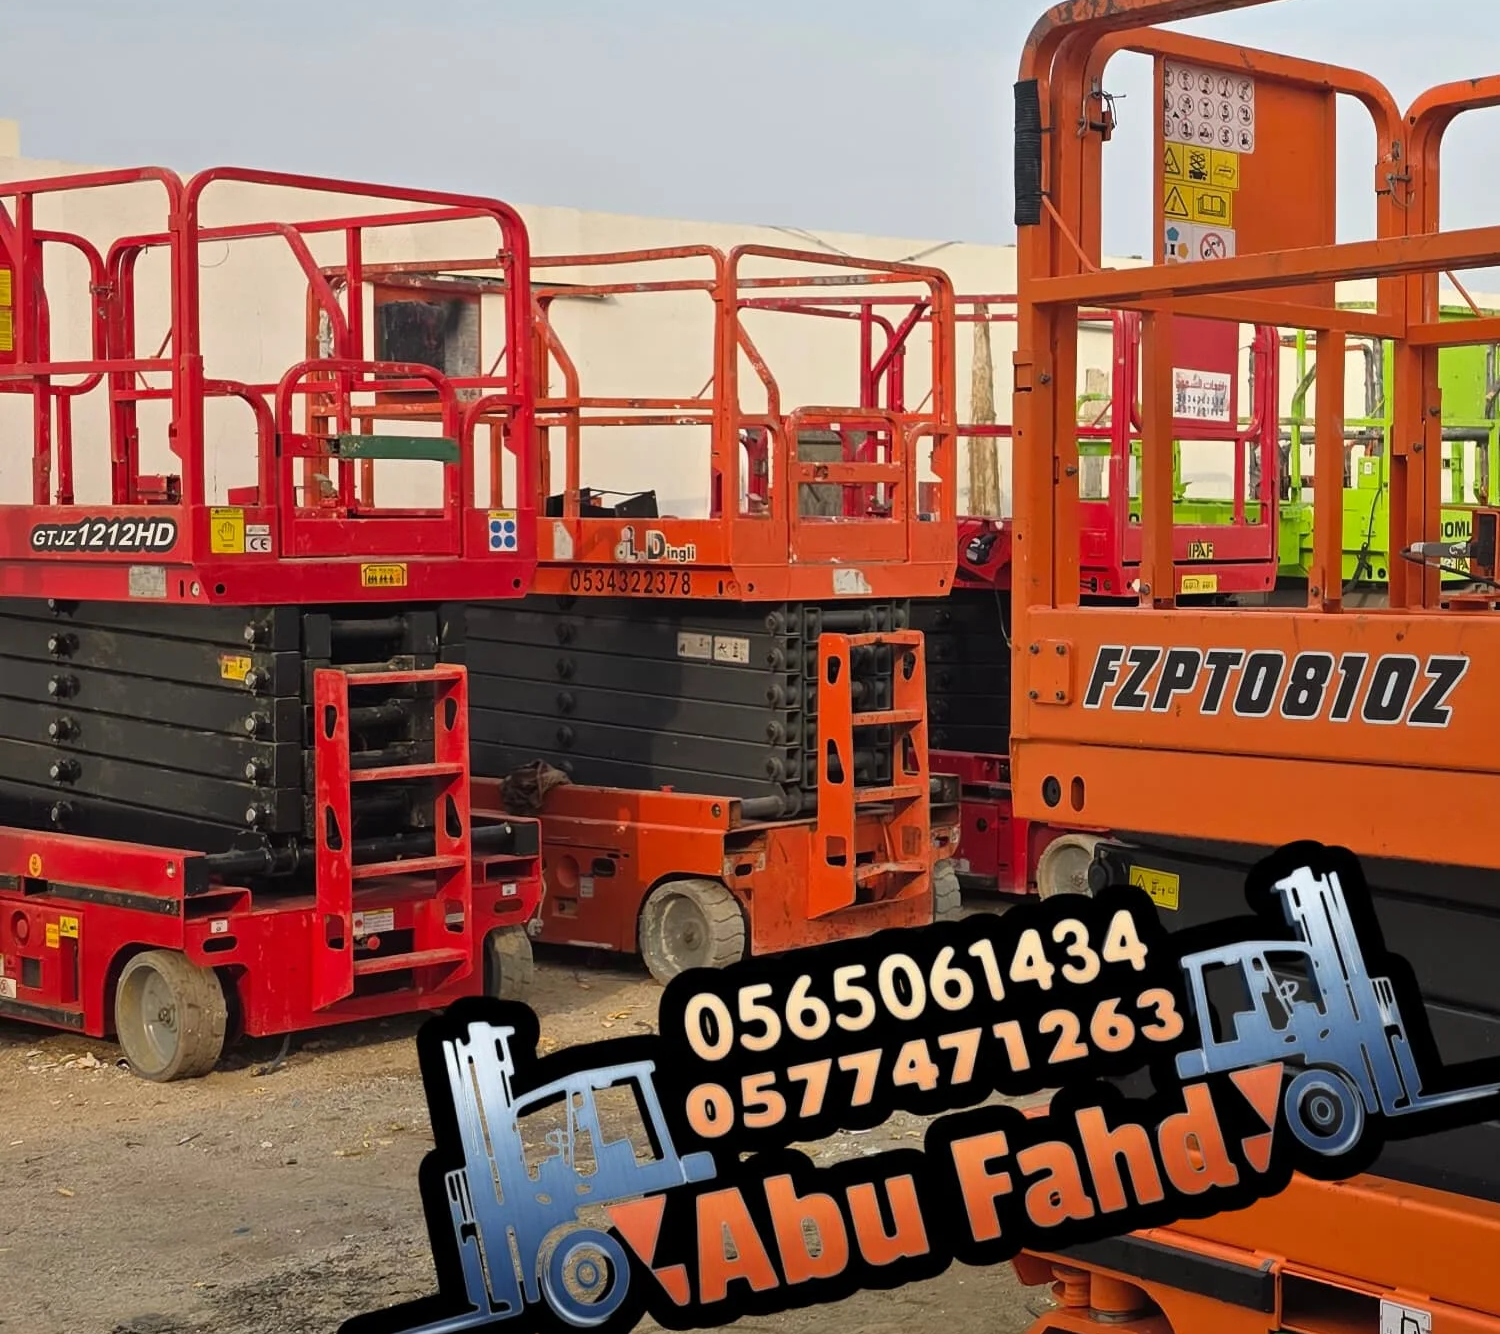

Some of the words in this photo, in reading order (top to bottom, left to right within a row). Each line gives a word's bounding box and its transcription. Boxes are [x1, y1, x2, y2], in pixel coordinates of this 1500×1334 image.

[33, 523, 175, 547] GTJZ1212HD
[647, 530, 696, 562] Dingli
[1188, 541, 1213, 558] IPAF
[569, 569, 691, 595] 0534322378
[1083, 645, 1470, 728] FZPT0810Z
